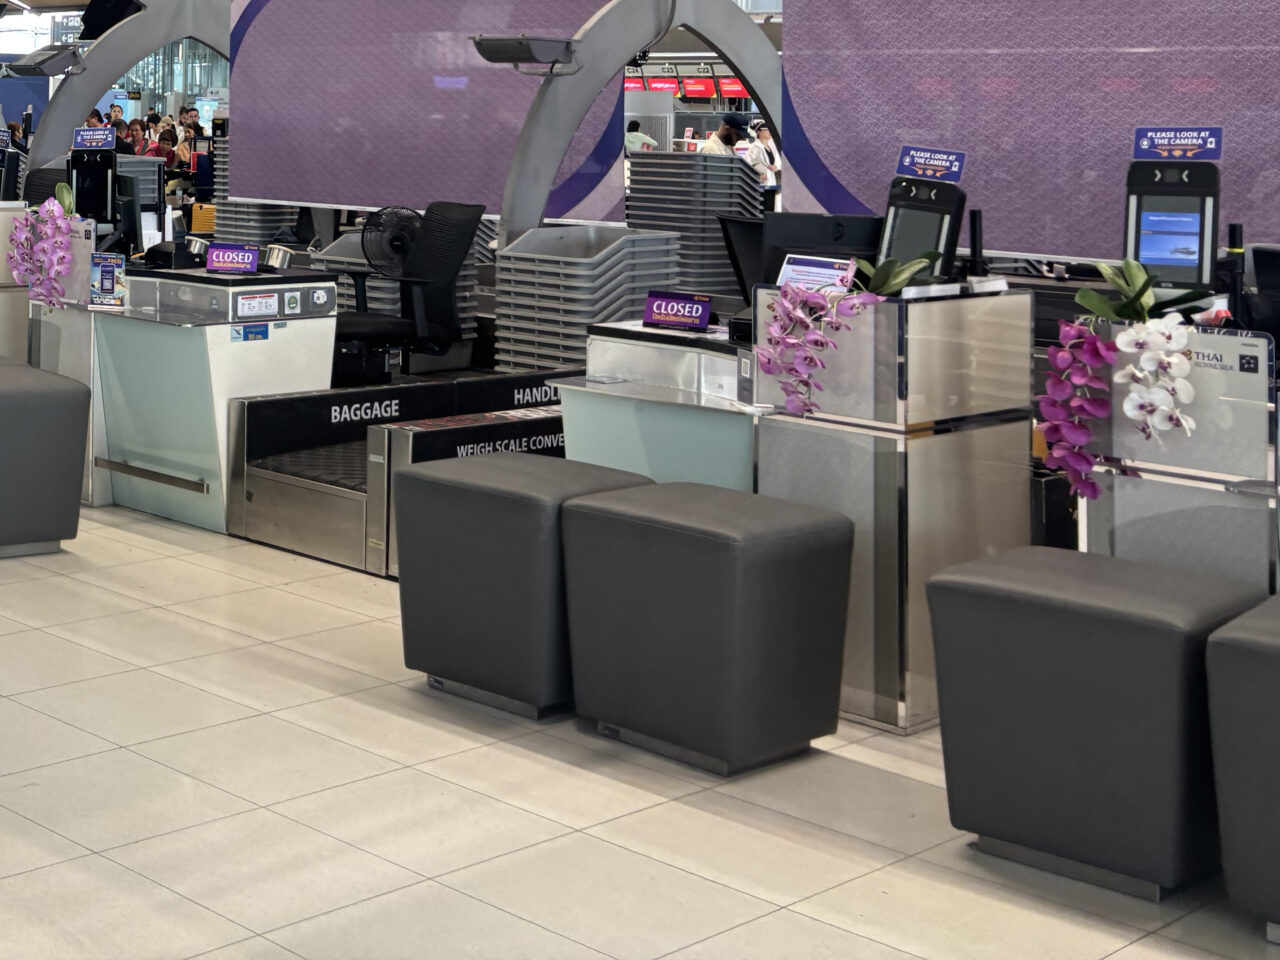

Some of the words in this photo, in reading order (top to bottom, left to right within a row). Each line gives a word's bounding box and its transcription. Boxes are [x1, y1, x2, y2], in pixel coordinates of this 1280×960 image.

[910, 150, 930, 158] PLEASE
[931, 152, 948, 160] LOOK
[926, 159, 950, 167] CAMERA
[212, 251, 253, 263] CLOSED
[653, 301, 702, 317] CLOSED
[1194, 351, 1223, 363] THAI
[331, 399, 400, 423] BAGGAGE
[457, 442, 493, 458] WEIGH
[496, 437, 528, 452] SCALE
